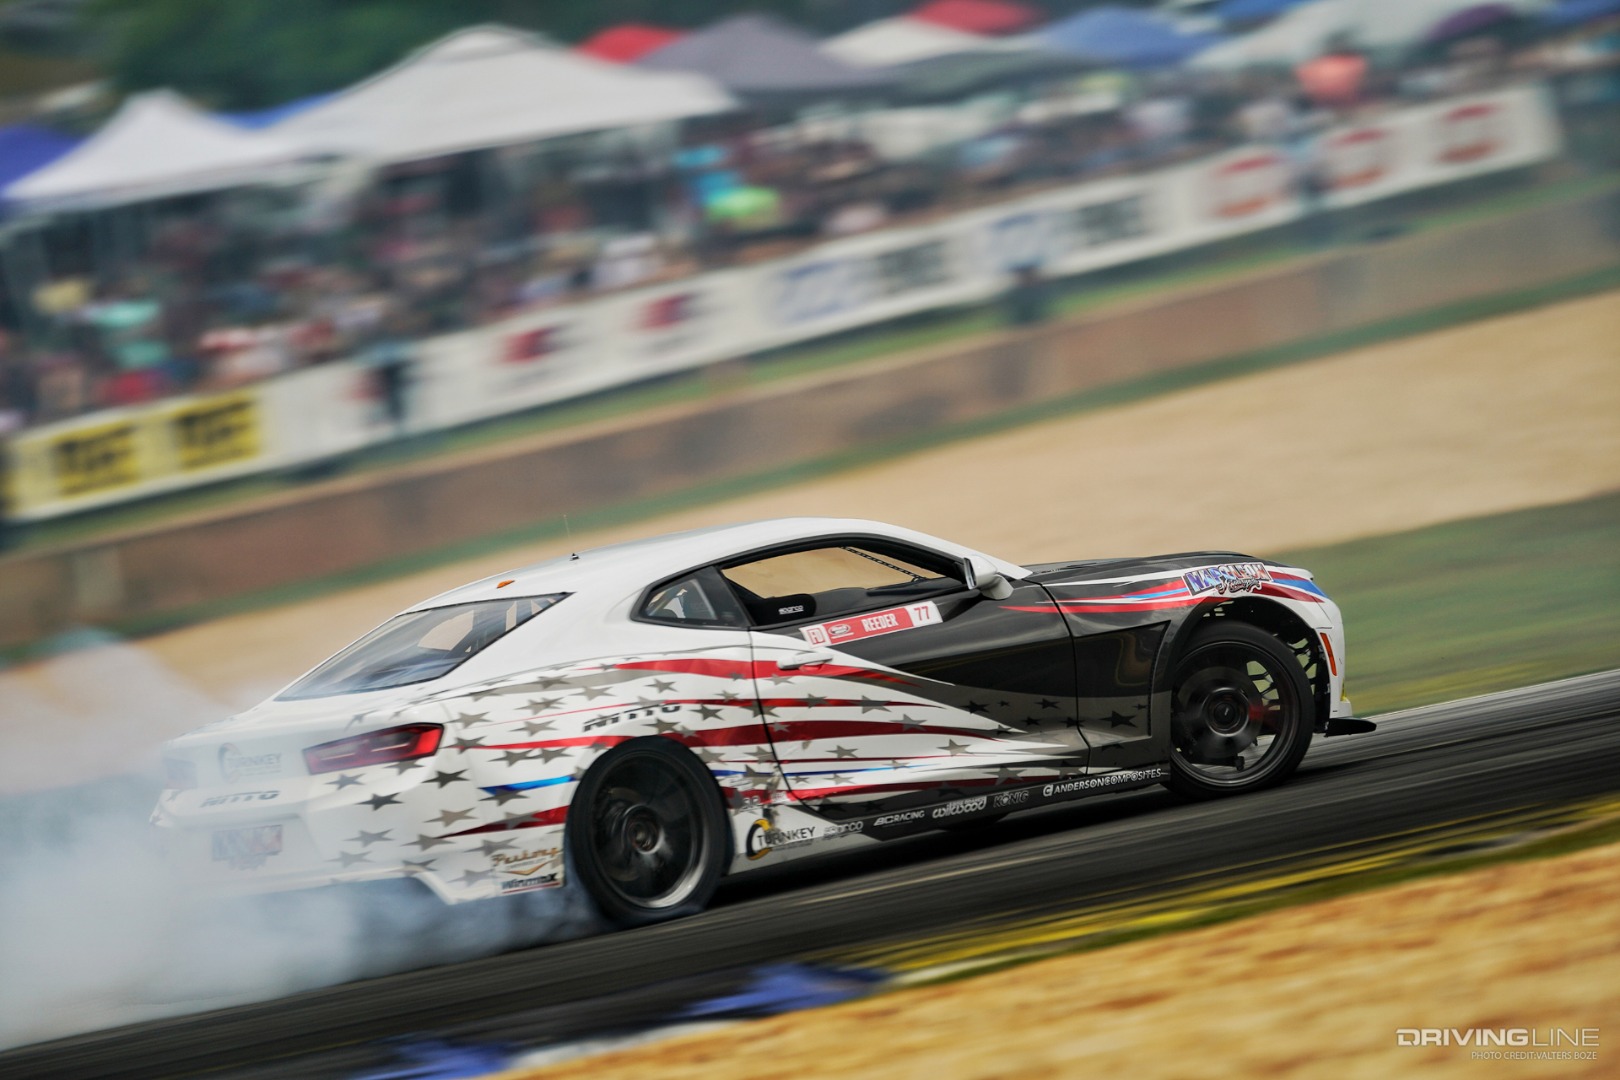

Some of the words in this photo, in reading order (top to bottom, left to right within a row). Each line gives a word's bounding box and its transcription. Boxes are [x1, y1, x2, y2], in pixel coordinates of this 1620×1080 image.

[861, 613, 899, 632] REEDER
[914, 605, 930, 621] 77
[583, 702, 681, 732] NITTO
[199, 790, 281, 808] NITTO
[756, 826, 816, 847] TURNKEY
